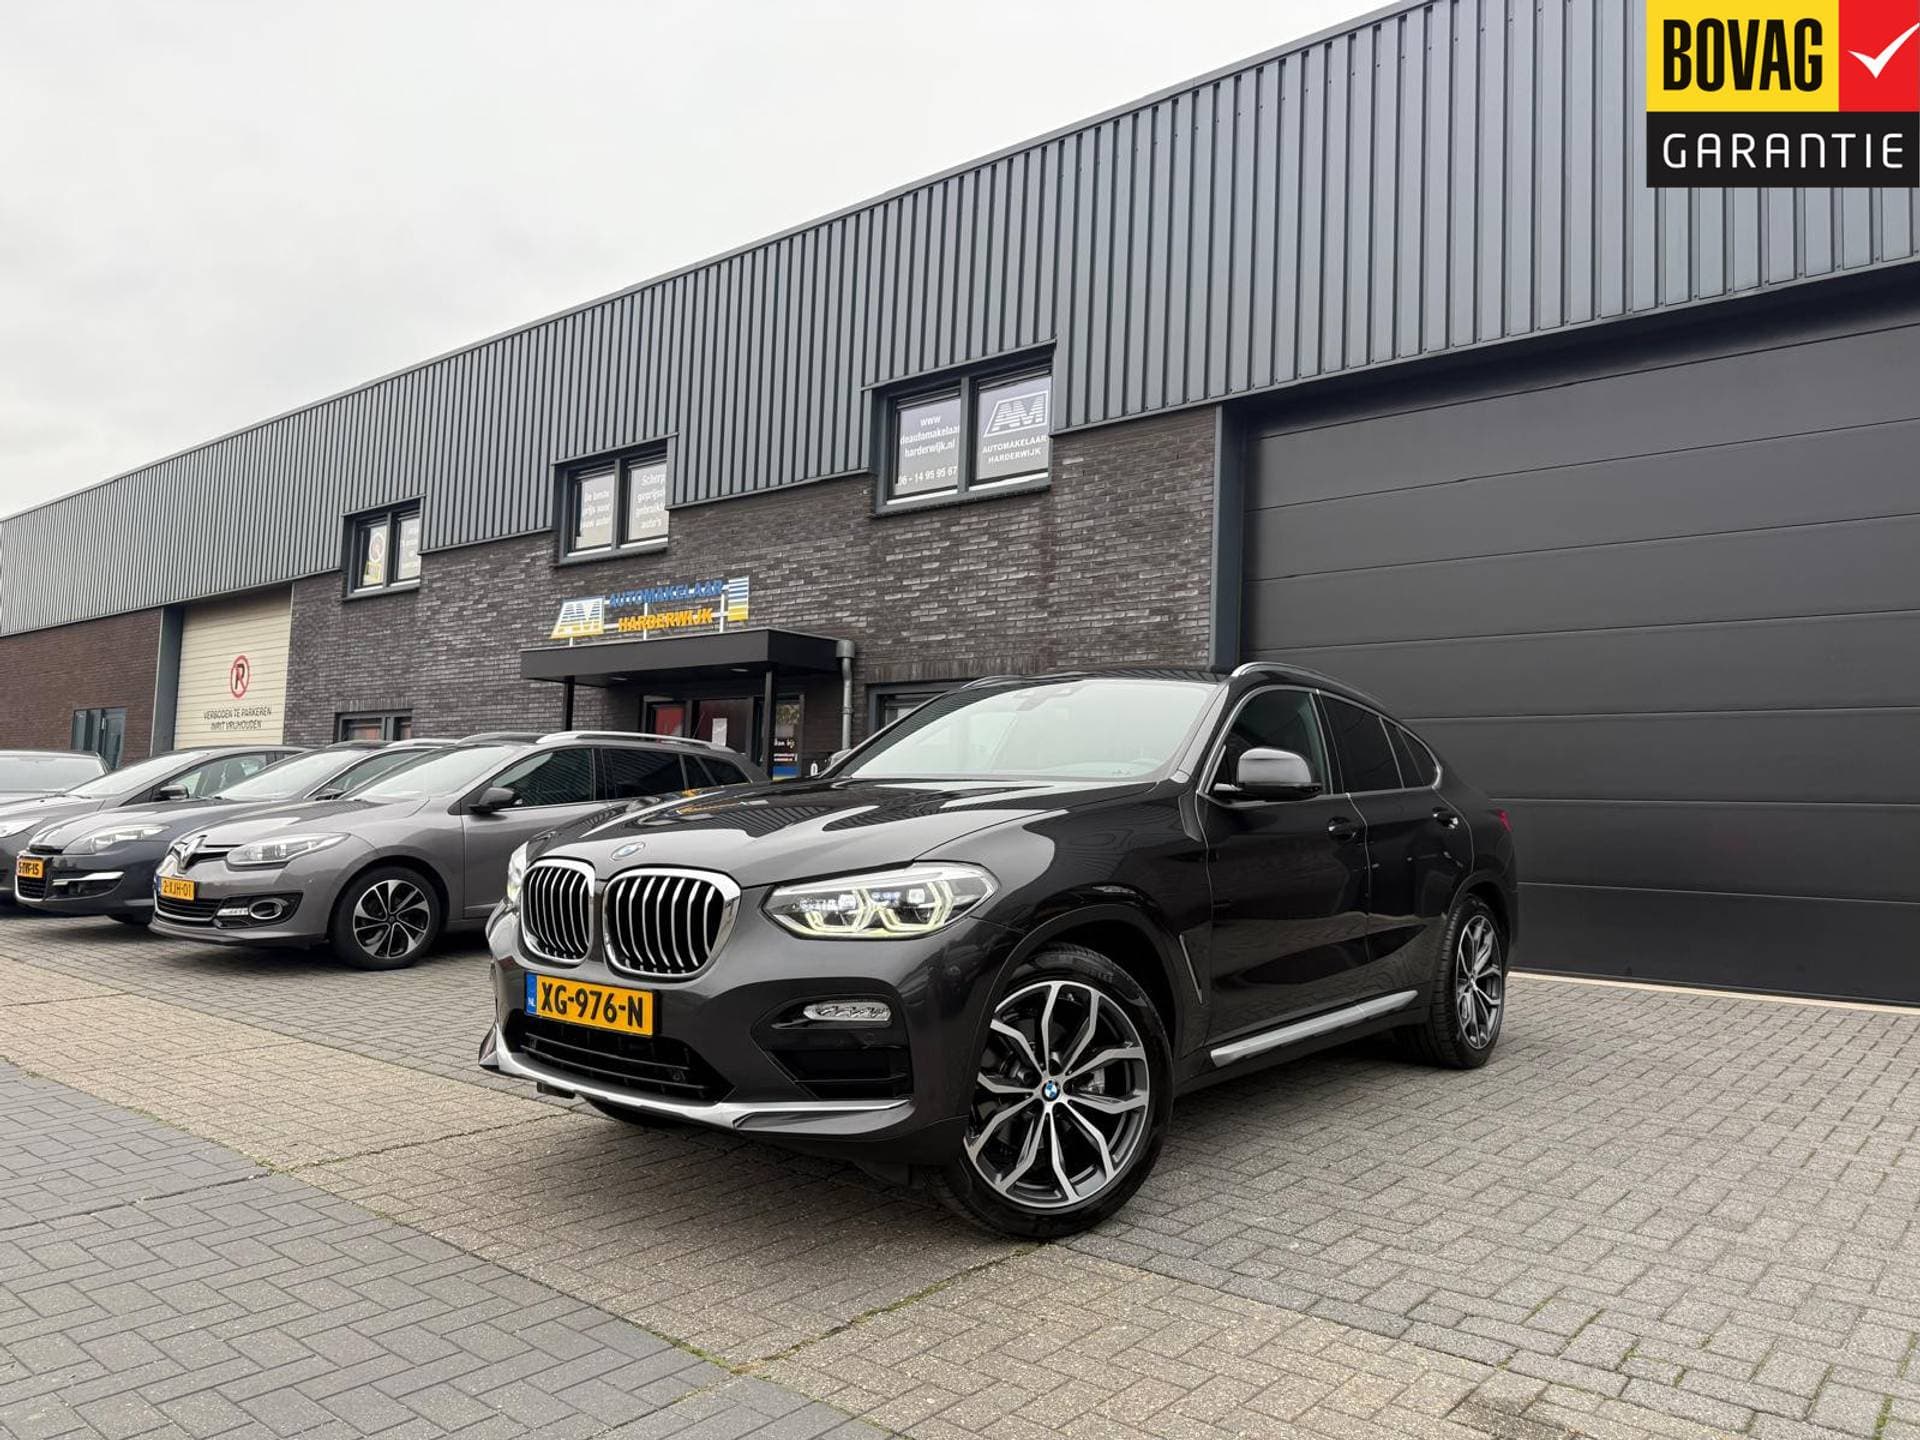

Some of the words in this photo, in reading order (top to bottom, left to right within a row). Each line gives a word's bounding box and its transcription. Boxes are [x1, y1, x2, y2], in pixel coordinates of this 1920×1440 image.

[988, 447, 1042, 464] HARDERWIJK
[609, 580, 723, 607] AUTOMAKELAAR
[618, 608, 713, 632] HARDERWIJK
[541, 981, 643, 1029] XG-976-N
